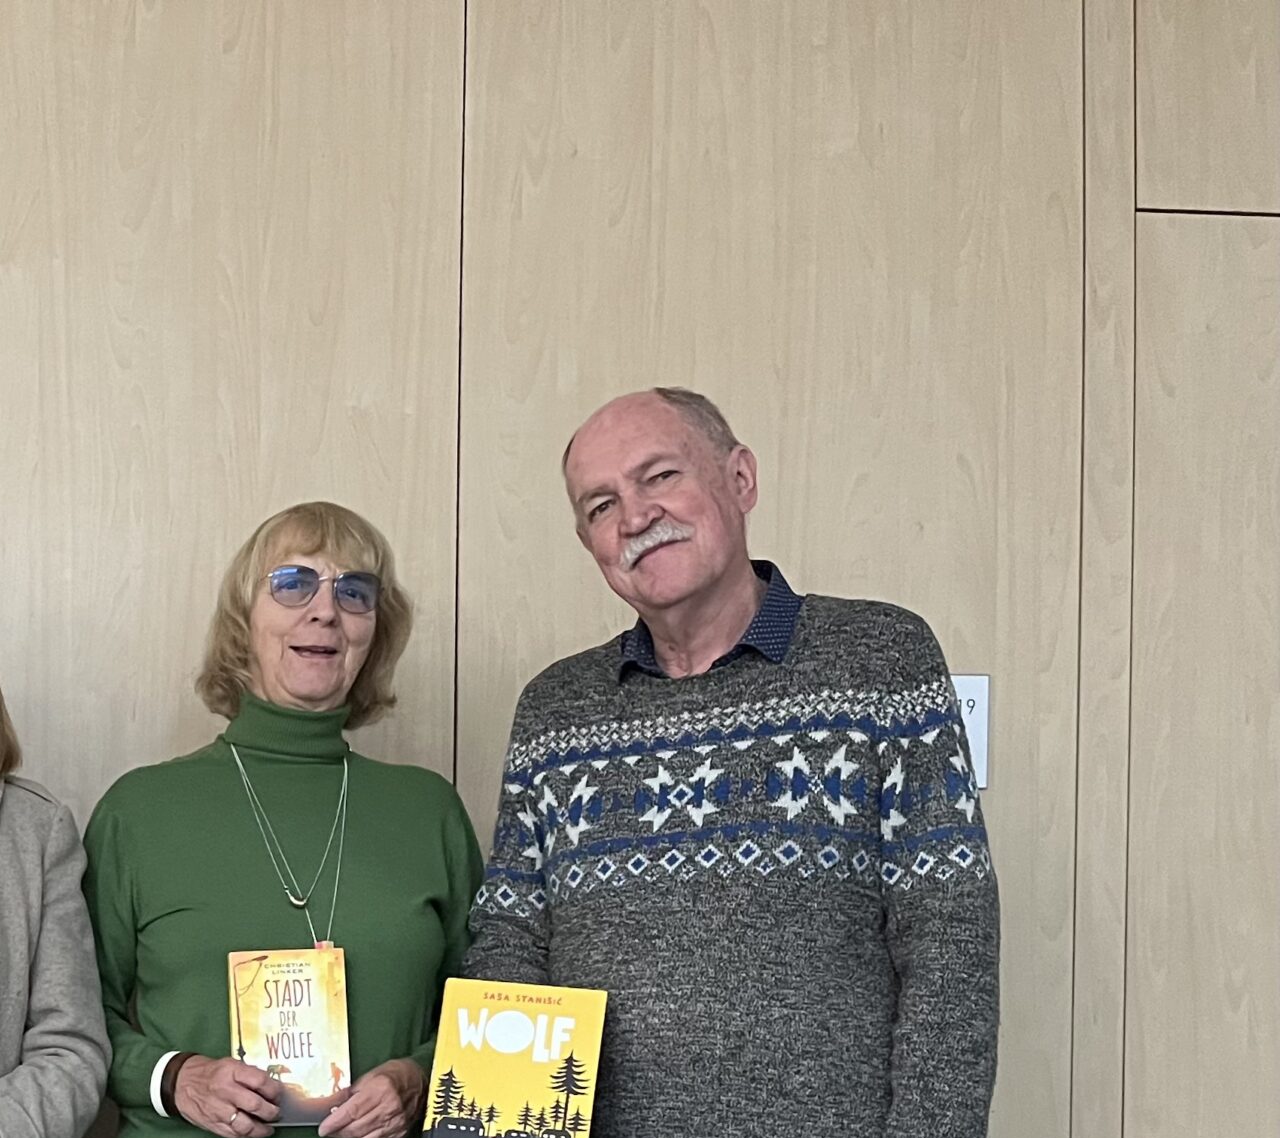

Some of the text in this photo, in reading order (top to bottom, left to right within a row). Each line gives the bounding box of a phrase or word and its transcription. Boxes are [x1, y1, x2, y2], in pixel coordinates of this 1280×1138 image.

[264, 978, 312, 1009] STADT
[483, 991, 510, 1002] SAŠA
[279, 1010, 298, 1027] DER
[265, 1027, 315, 1060] WÖLFE
[457, 1007, 575, 1063] WOLF
